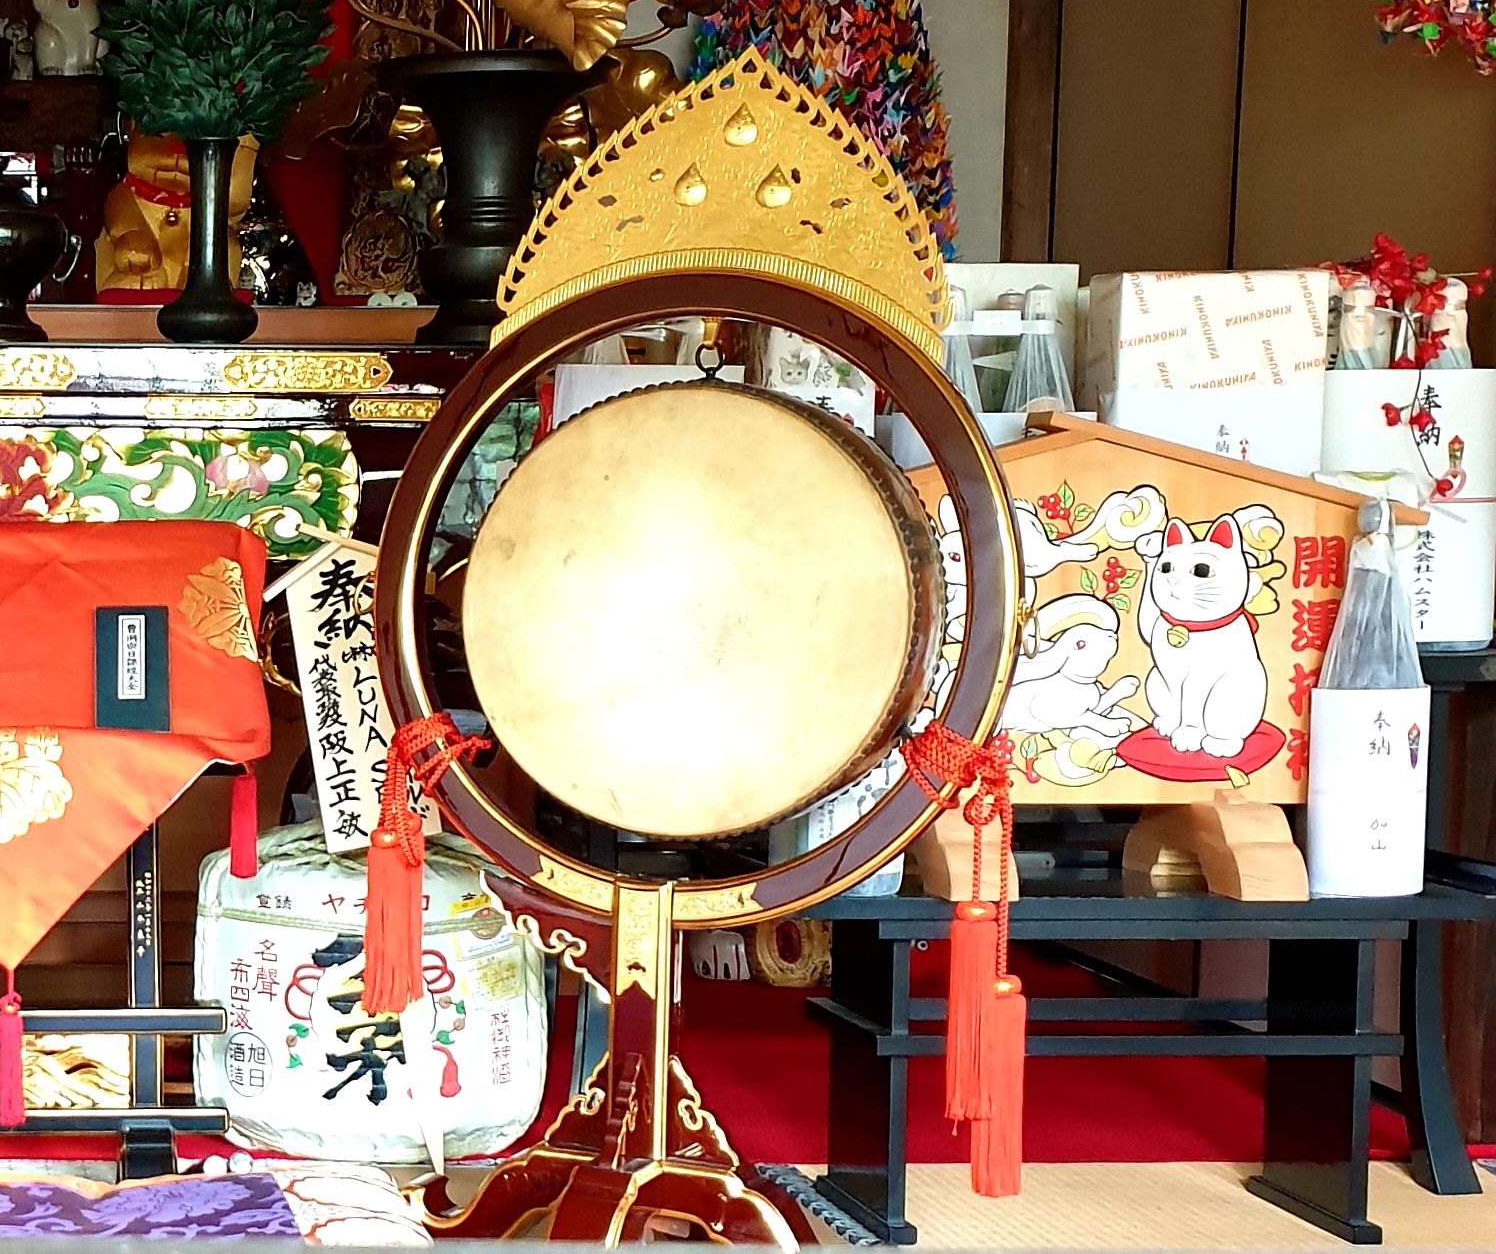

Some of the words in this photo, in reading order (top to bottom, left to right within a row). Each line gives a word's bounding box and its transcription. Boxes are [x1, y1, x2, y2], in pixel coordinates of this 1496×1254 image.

[1193, 295, 1220, 359] KINOKUNIYA
[1225, 305, 1292, 327] KINOKUNIYA
[1297, 274, 1324, 337] KINOKUNIYA
[1369, 710, 1391, 756] 奉納
